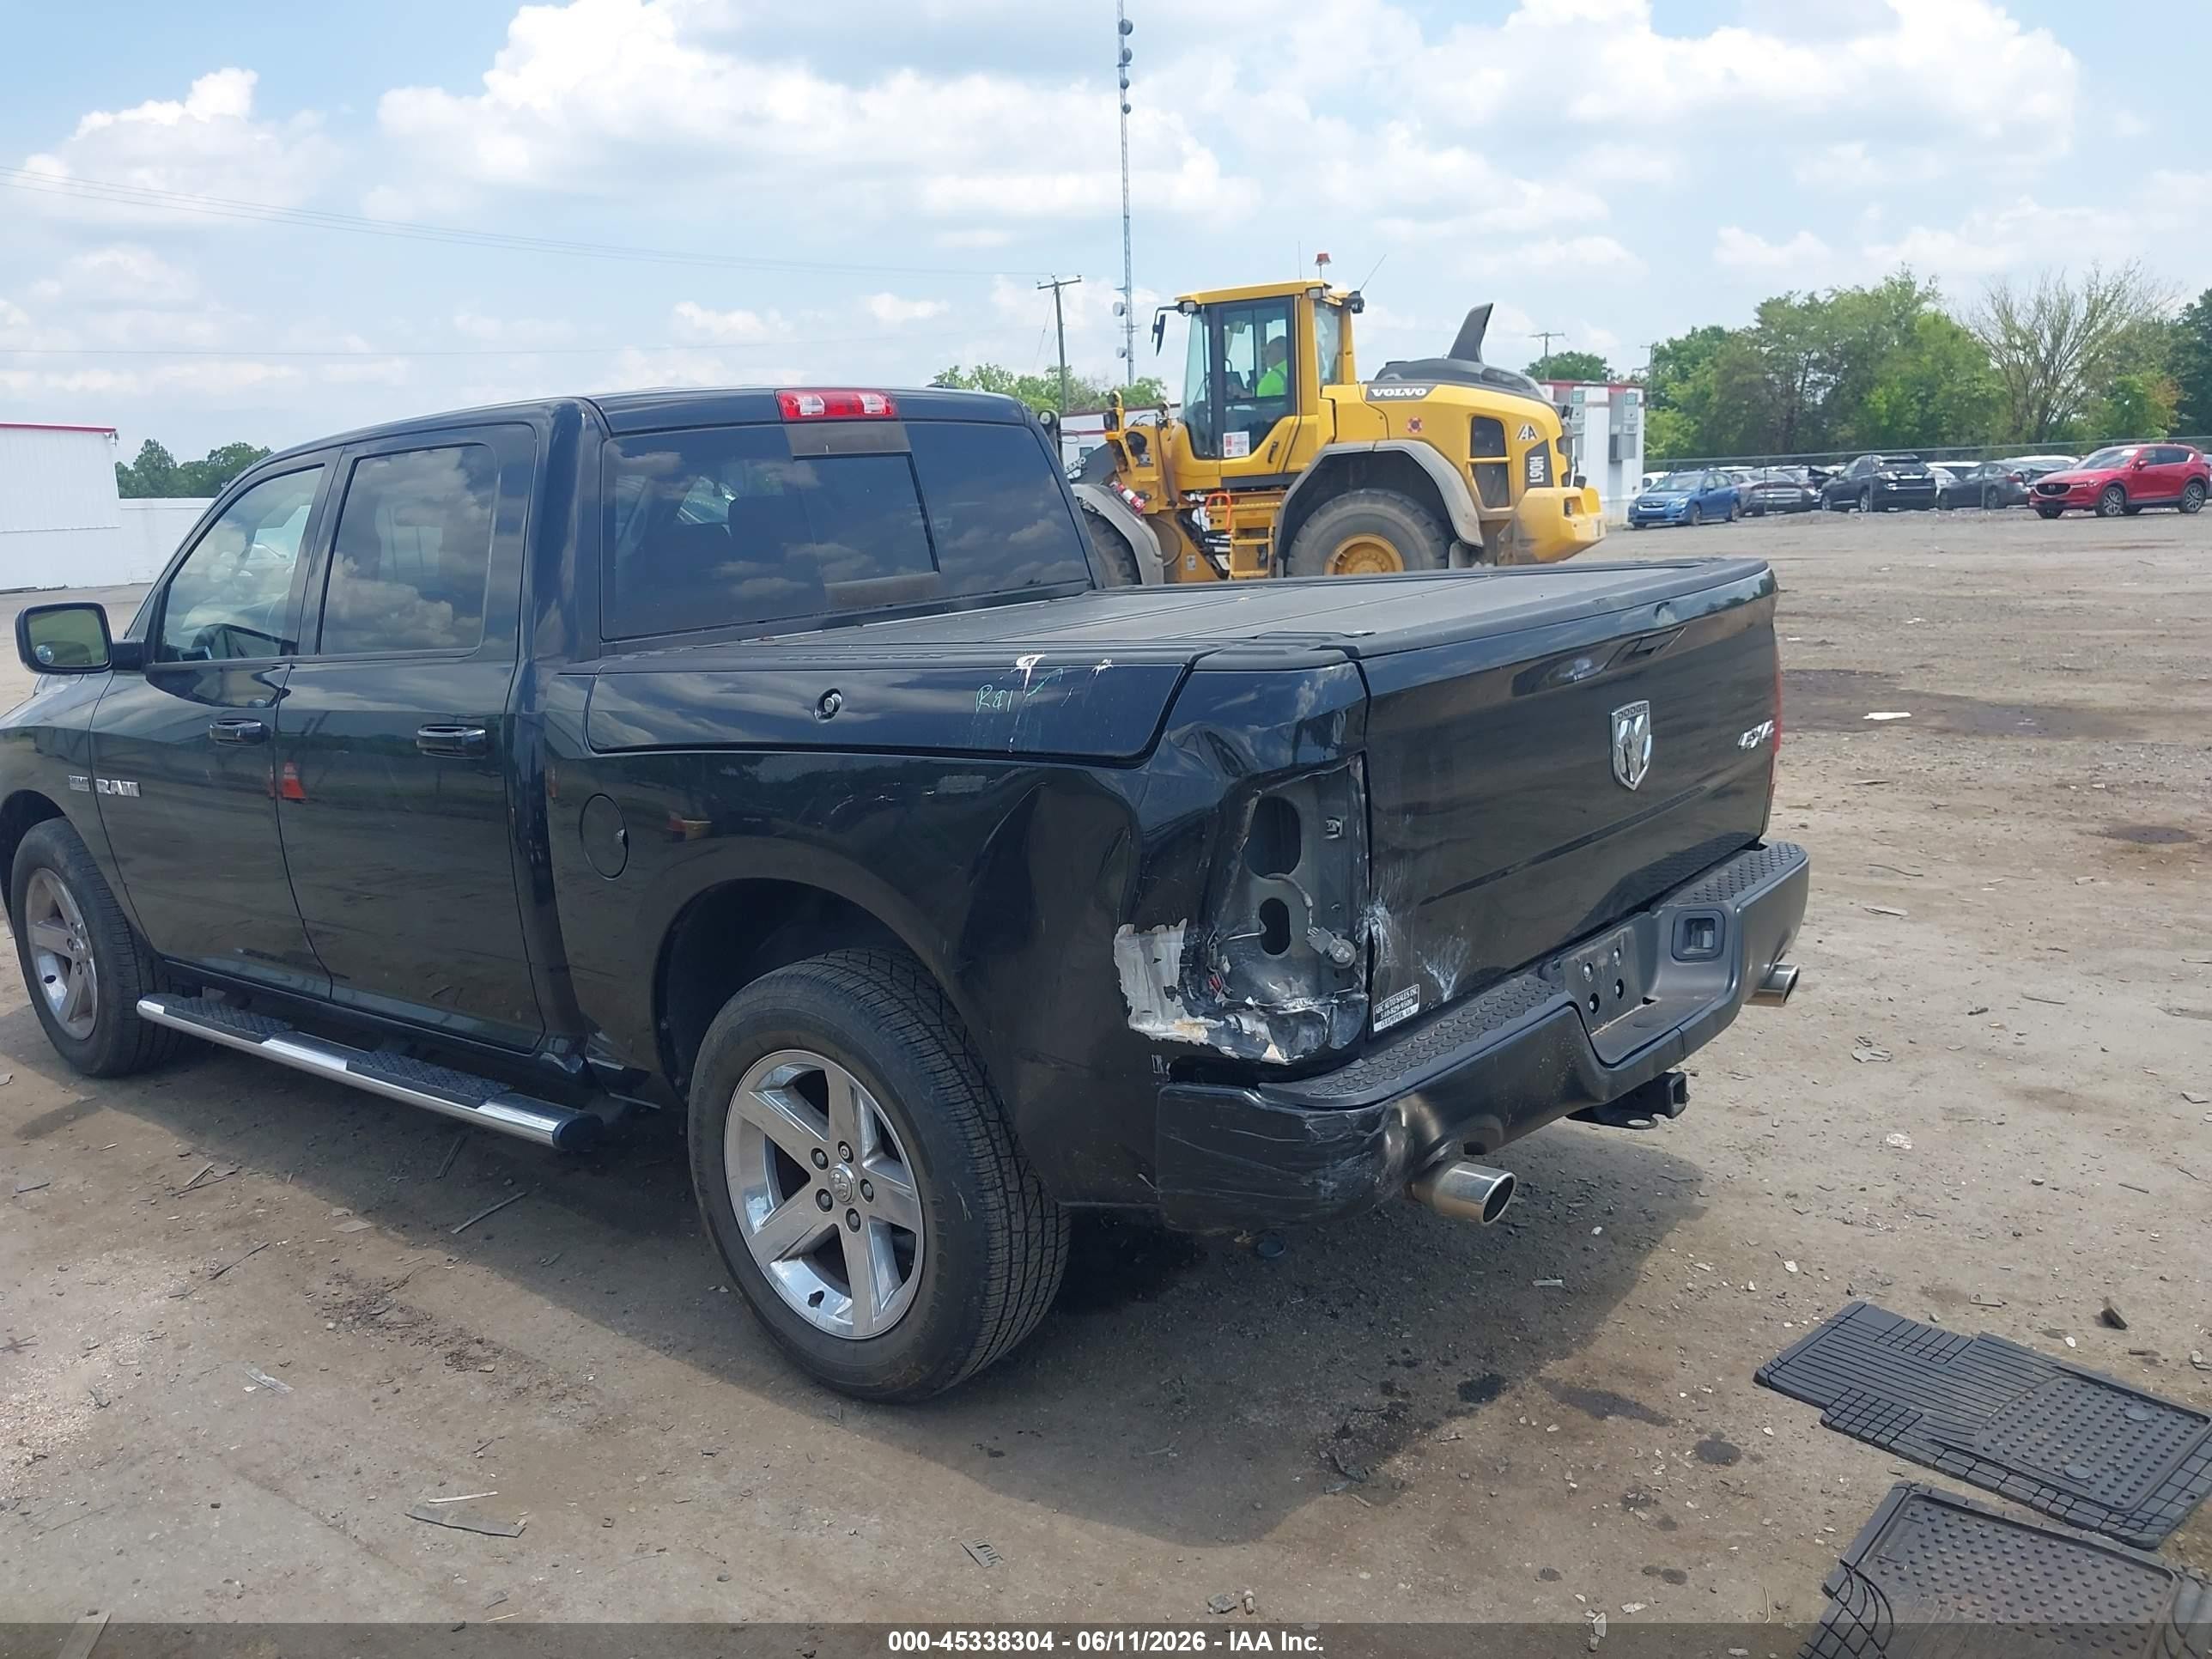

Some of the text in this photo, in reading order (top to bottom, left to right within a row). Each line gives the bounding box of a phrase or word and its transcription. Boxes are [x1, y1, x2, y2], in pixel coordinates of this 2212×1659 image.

[1371, 388, 1426, 397] VOLVO
[1528, 456, 1544, 483] L90H
[1617, 703, 1648, 720] DODGE
[96, 778, 140, 797] RAM
